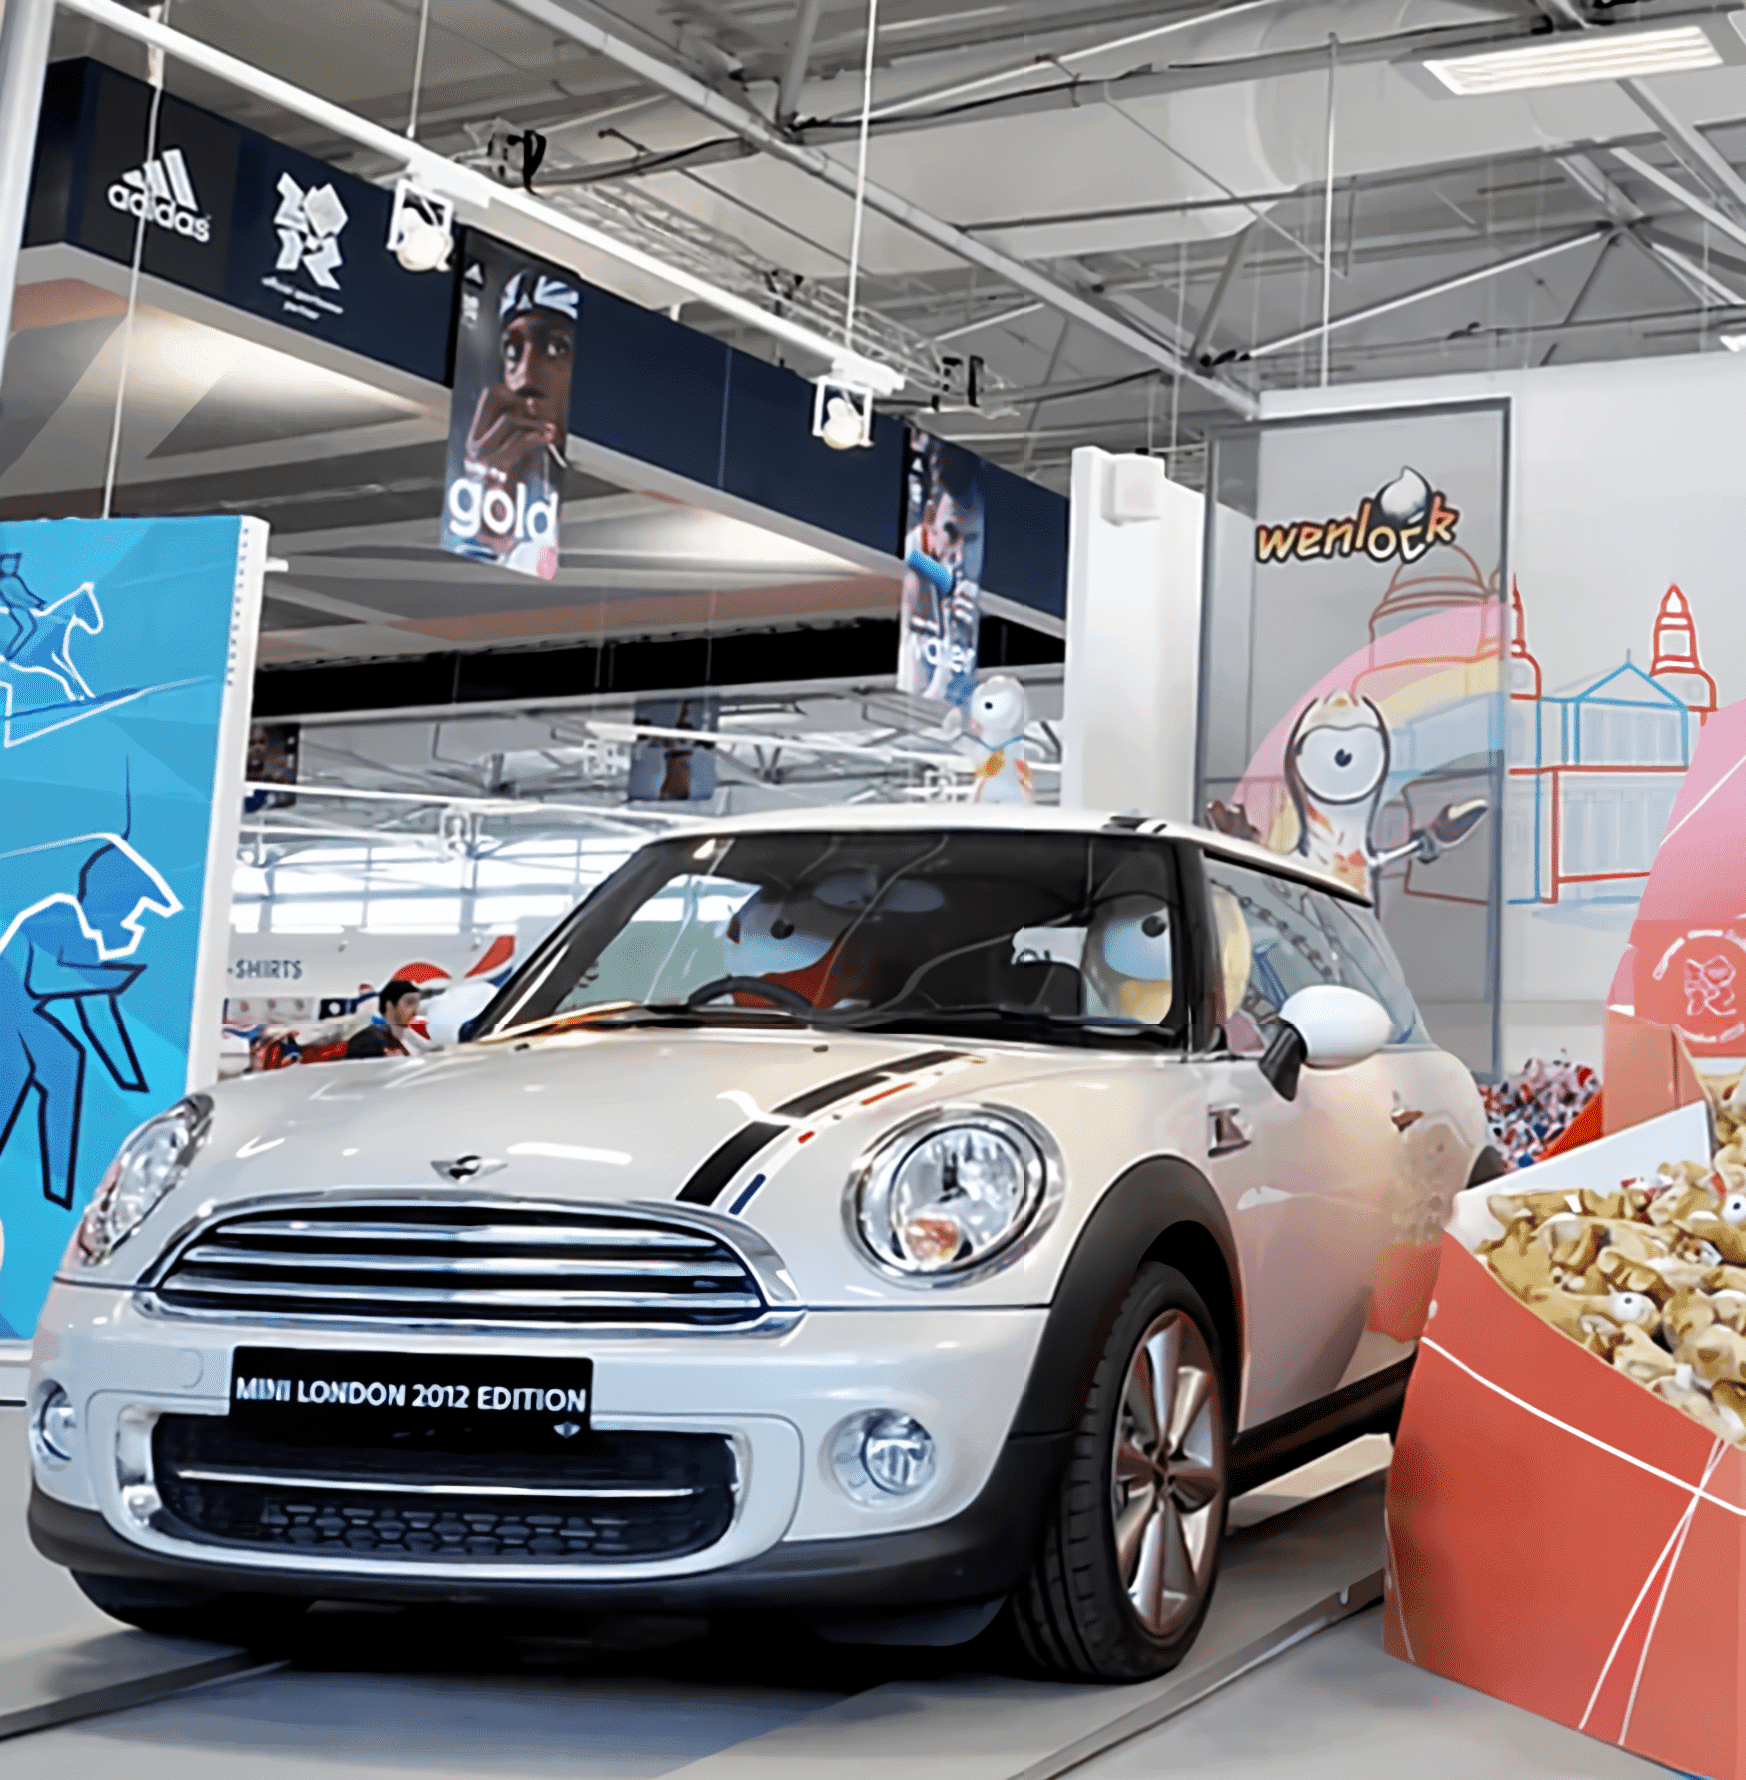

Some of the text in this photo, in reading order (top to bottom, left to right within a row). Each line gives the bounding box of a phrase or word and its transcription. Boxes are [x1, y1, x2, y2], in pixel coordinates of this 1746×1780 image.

[107, 184, 210, 242] adidas
[448, 477, 559, 541] gold
[1255, 490, 1460, 564] wenlock
[235, 1375, 587, 1413] MINI LONDON 2012 EDITION
